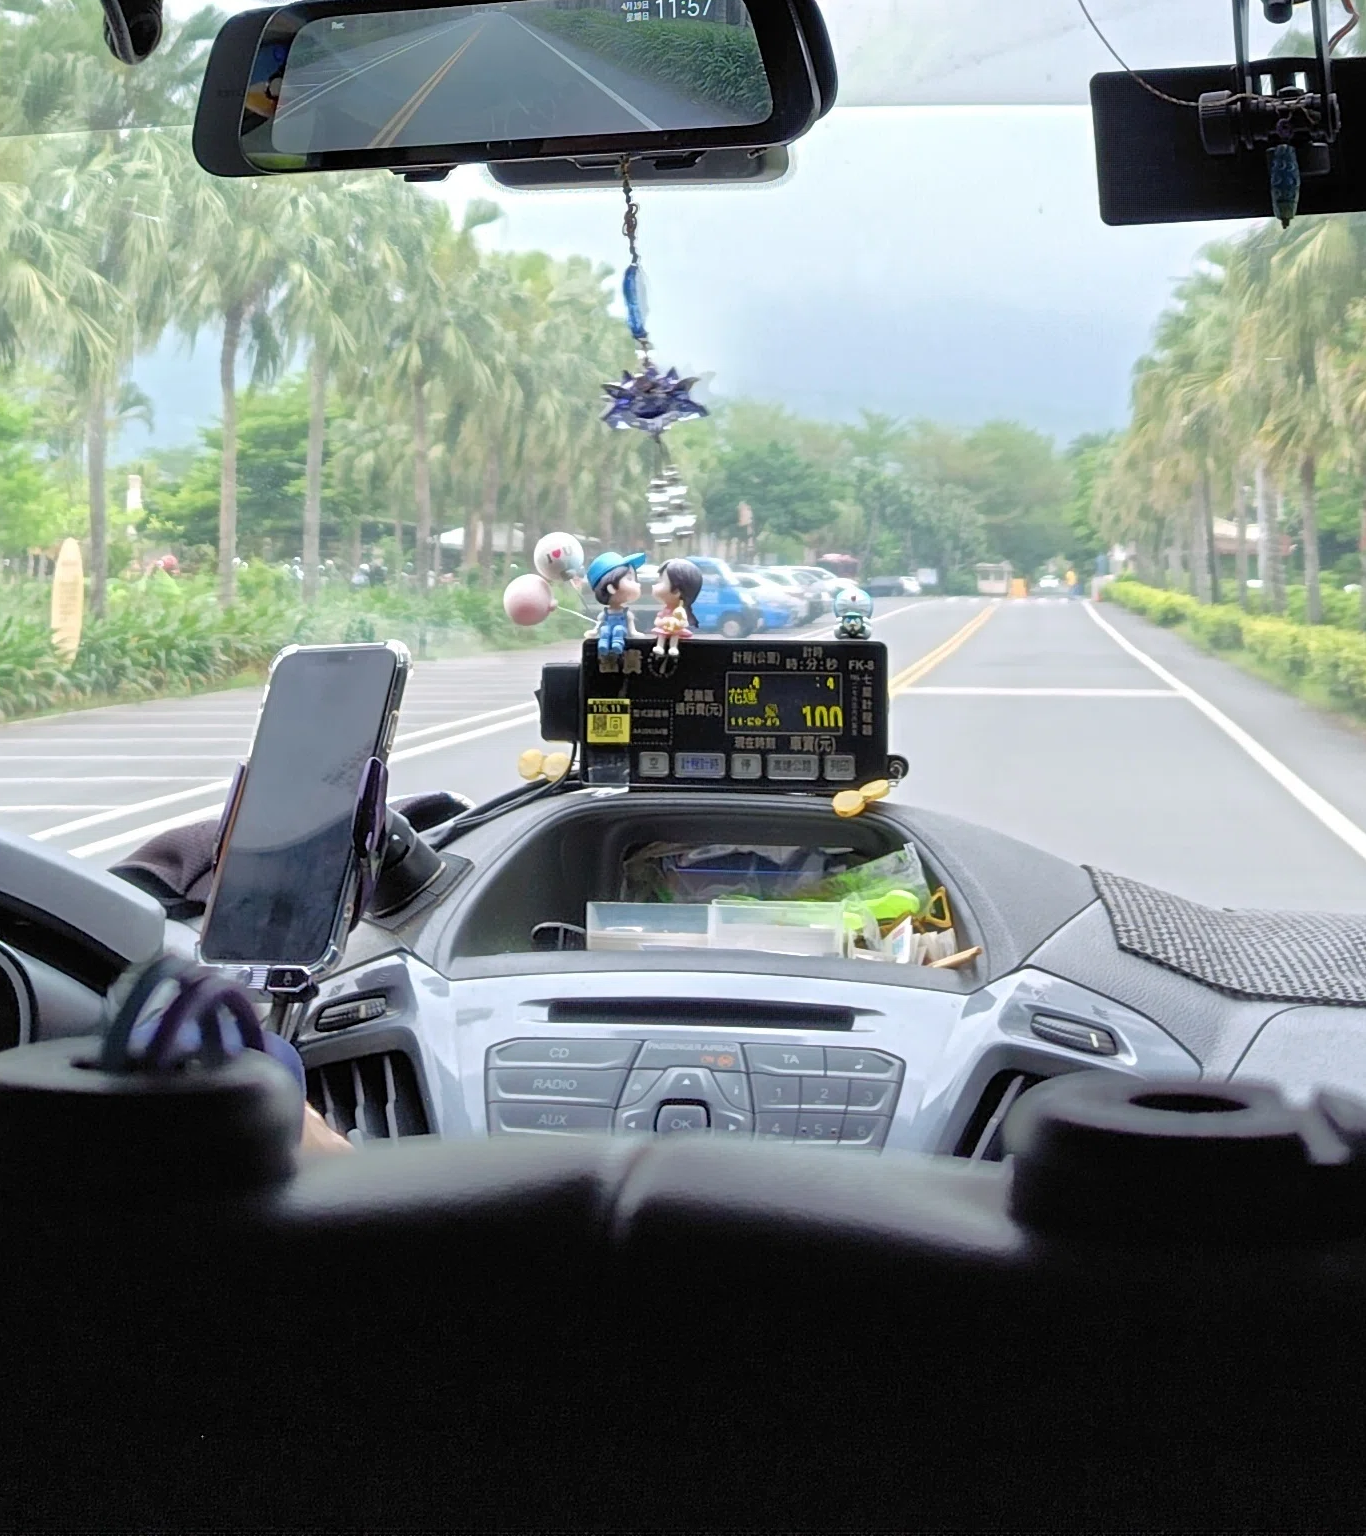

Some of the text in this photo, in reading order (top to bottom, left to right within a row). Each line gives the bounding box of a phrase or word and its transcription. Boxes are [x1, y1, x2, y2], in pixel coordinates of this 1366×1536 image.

[848, 660, 875, 671] FK-8
[728, 687, 758, 705] 花蓮
[801, 705, 844, 728] 100
[549, 1047, 569, 1059] CD
[782, 1054, 800, 1064] TA
[533, 1078, 578, 1090] RADIO
[820, 1088, 830, 1099] 2
[537, 1114, 568, 1126] AUX
[671, 1118, 693, 1130] OK
